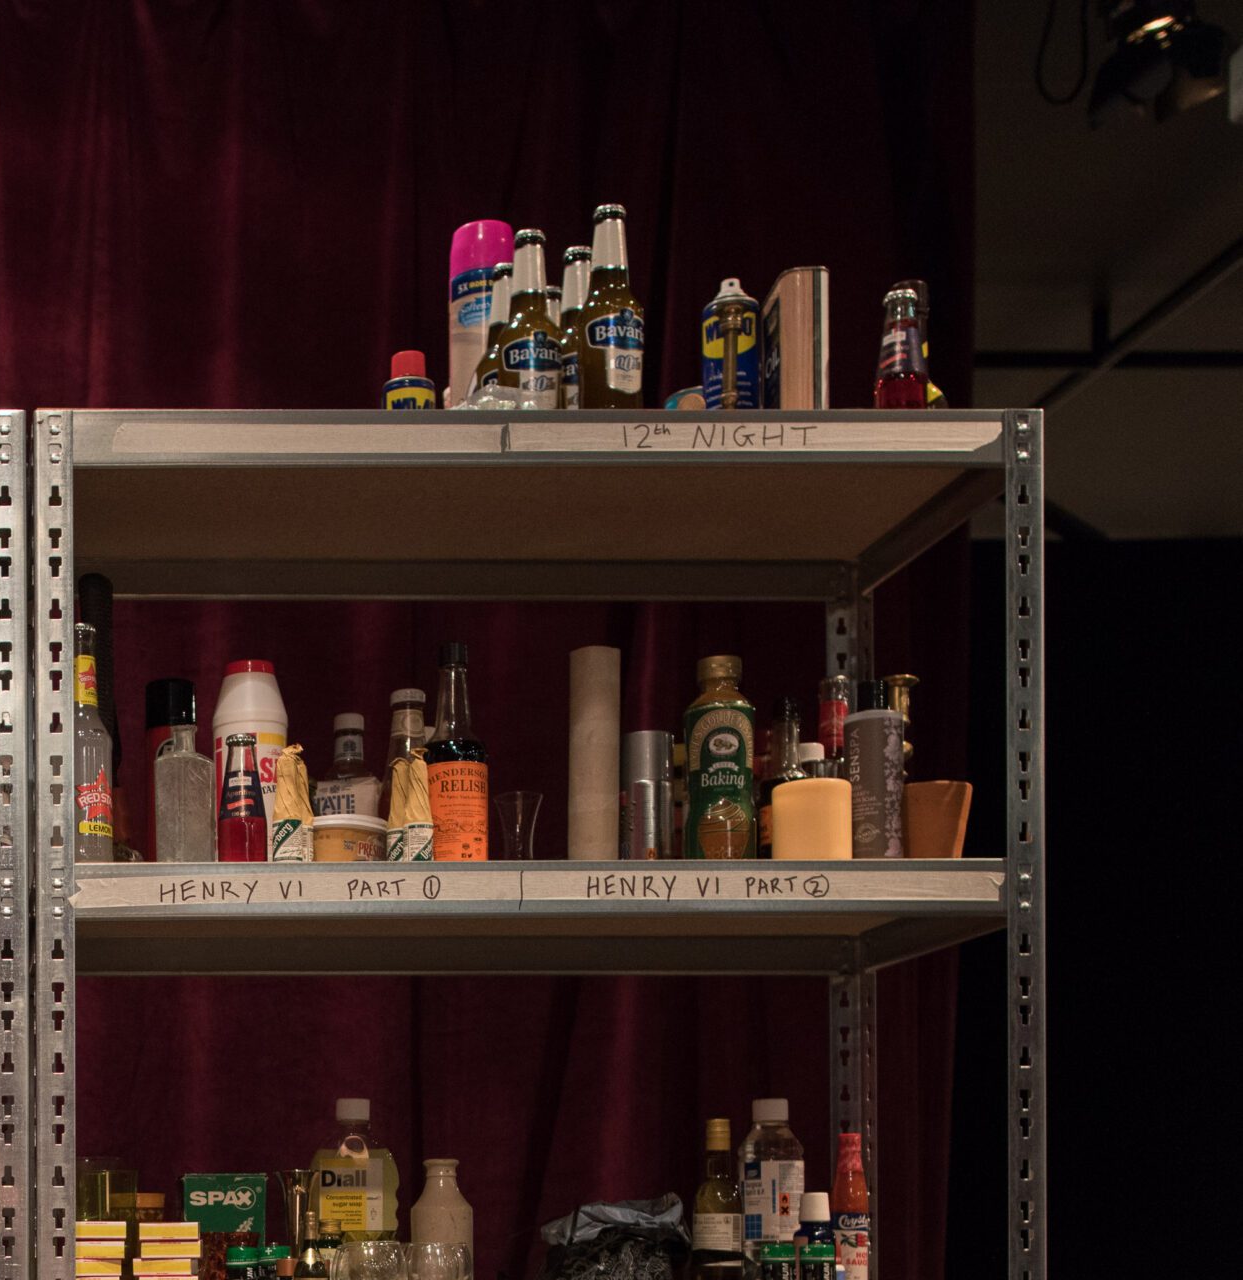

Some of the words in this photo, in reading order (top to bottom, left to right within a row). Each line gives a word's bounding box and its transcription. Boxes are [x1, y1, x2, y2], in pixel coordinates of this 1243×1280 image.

[595, 320, 645, 341] Bavari
[509, 346, 560, 364] Bavari
[622, 424, 671, 449] 12th
[693, 425, 818, 448] NIGHT
[850, 728, 859, 782] SENSPA
[440, 779, 486, 794] RELISH
[700, 772, 746, 789] Baking
[78, 792, 101, 807] RED
[159, 879, 259, 905] HENRY
[279, 880, 303, 900] VI
[347, 878, 406, 900] PART
[586, 874, 677, 903] HENRY
[697, 876, 720, 898] VI
[744, 875, 798, 897] PART
[321, 1169, 366, 1187] Diall
[189, 1190, 253, 1207] SPAX
[325, 1193, 363, 1201] Concentrated
[846, 1258, 868, 1266] SAUC
